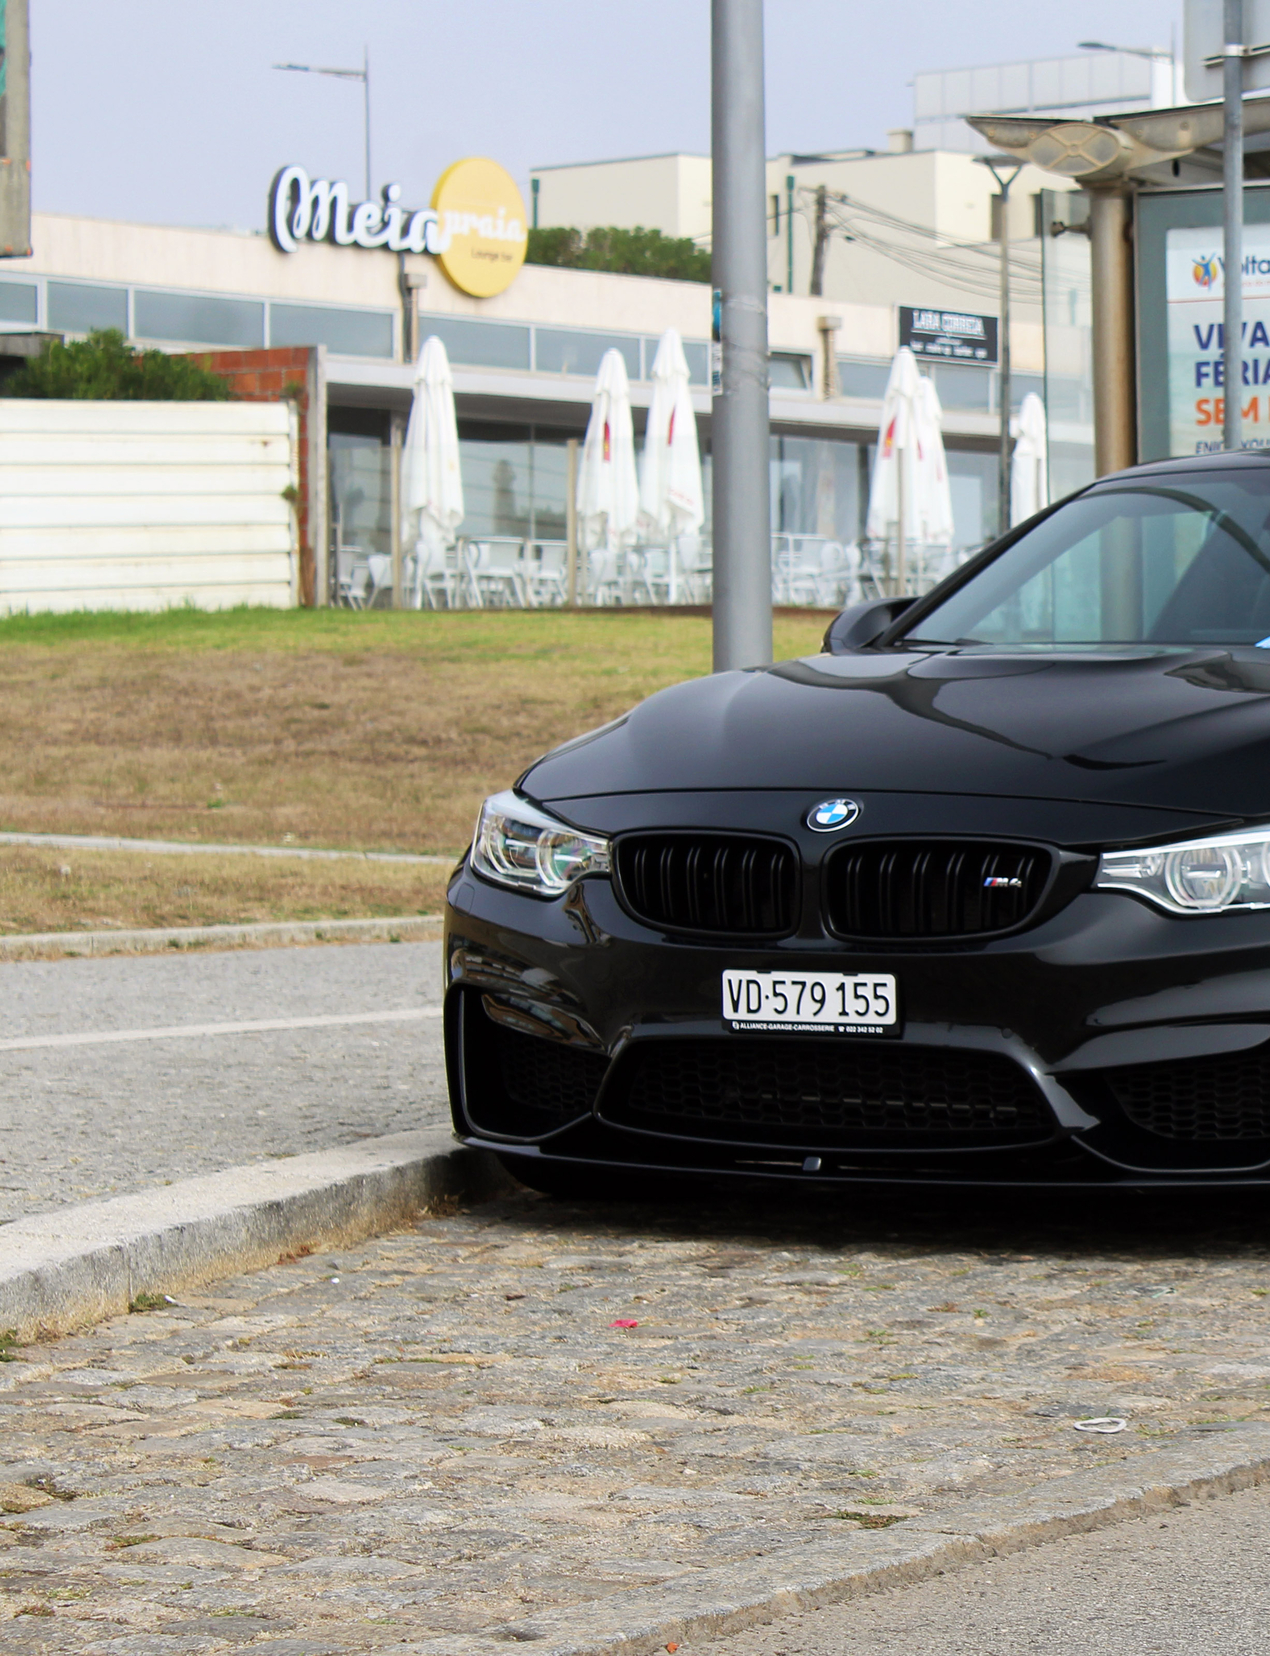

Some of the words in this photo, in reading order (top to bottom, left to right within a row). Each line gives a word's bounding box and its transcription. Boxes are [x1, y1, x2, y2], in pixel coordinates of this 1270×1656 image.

[269, 164, 441, 254] Meia
[441, 206, 526, 249] praia
[1194, 320, 1270, 351] VIA
[1195, 395, 1260, 426] SEM
